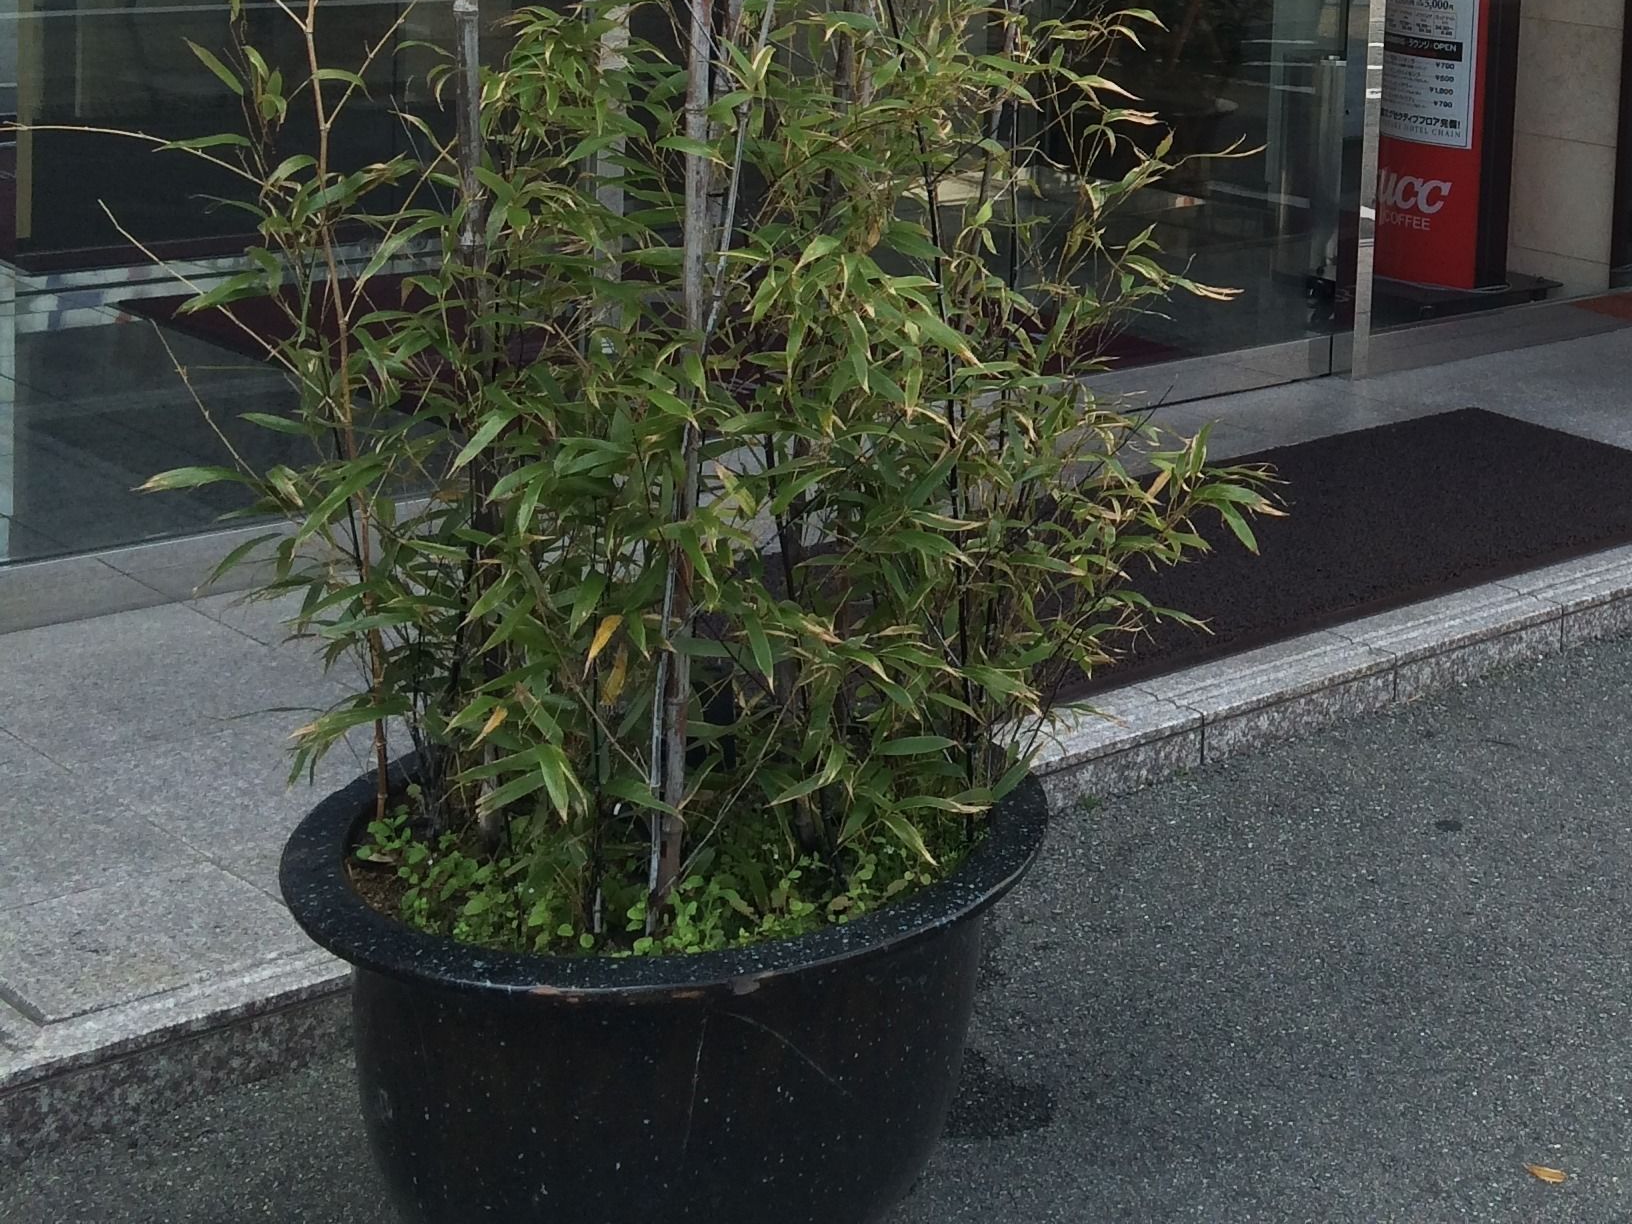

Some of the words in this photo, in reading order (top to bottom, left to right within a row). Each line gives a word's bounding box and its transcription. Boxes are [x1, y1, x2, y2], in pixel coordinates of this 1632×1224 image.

[1433, 42, 1457, 52] OPEN
[1379, 167, 1453, 214] UCC
[1384, 210, 1431, 231] COFFEE
